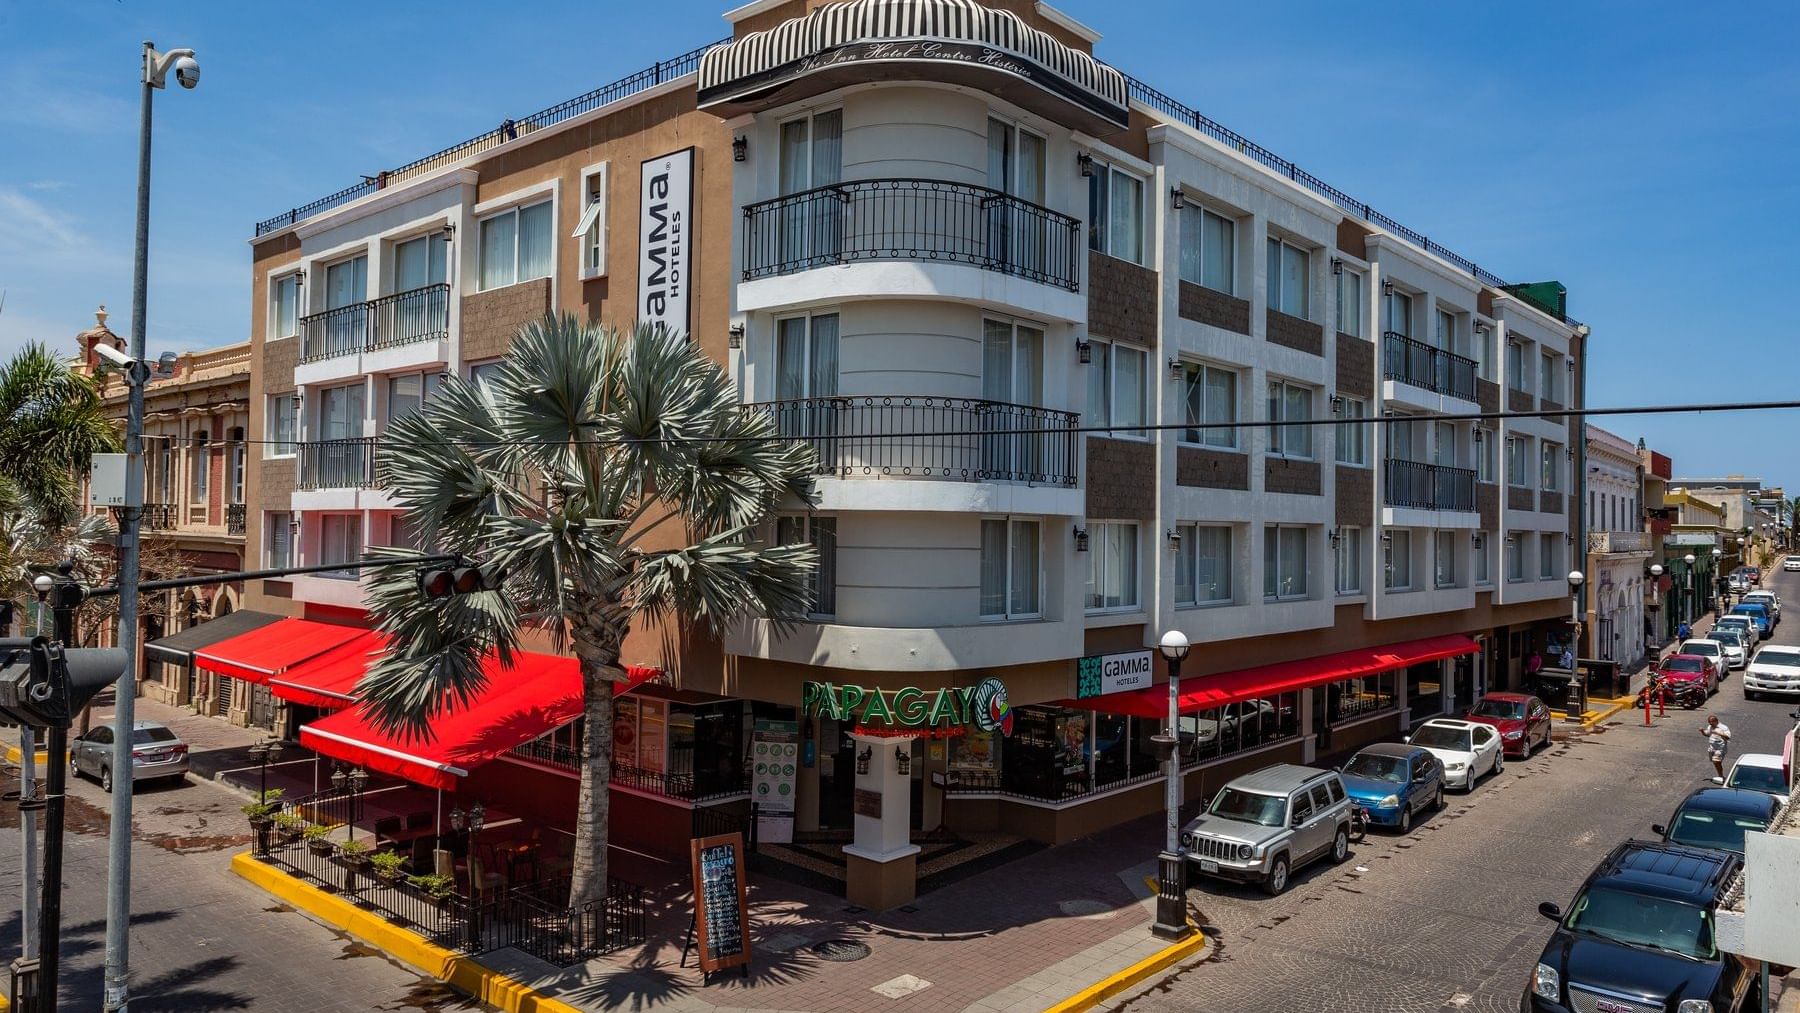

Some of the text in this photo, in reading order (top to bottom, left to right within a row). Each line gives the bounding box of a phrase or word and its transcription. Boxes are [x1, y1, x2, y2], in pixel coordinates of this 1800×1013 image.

[795, 54, 820, 73] The
[824, 47, 857, 64] Inn
[864, 42, 920, 59] Hotel
[921, 42, 972, 61] Centro
[670, 210, 681, 298] HOTELES
[1116, 676, 1139, 686] HOTELES
